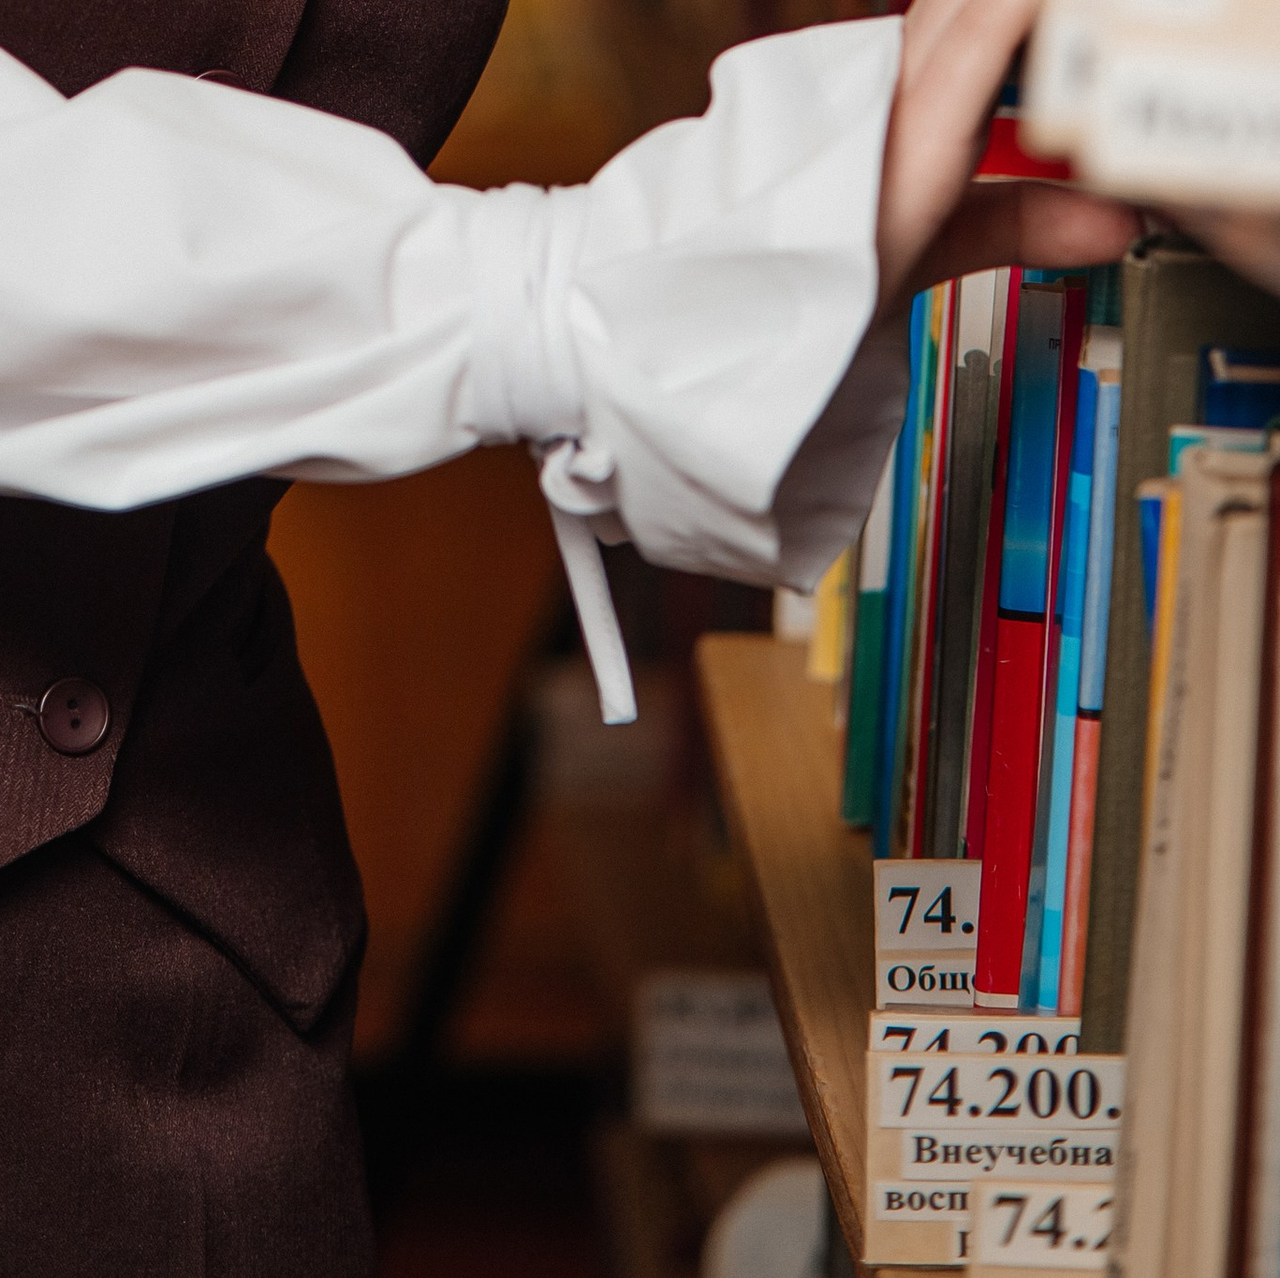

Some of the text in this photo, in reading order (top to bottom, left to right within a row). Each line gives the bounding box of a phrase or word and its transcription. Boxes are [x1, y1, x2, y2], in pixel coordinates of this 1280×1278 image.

[887, 886, 975, 935] 74.
[886, 964, 976, 995] Общ
[889, 1065, 1122, 1120] 74.200.
[912, 1135, 1114, 1172] Внеучебна
[884, 1190, 969, 1212] восп
